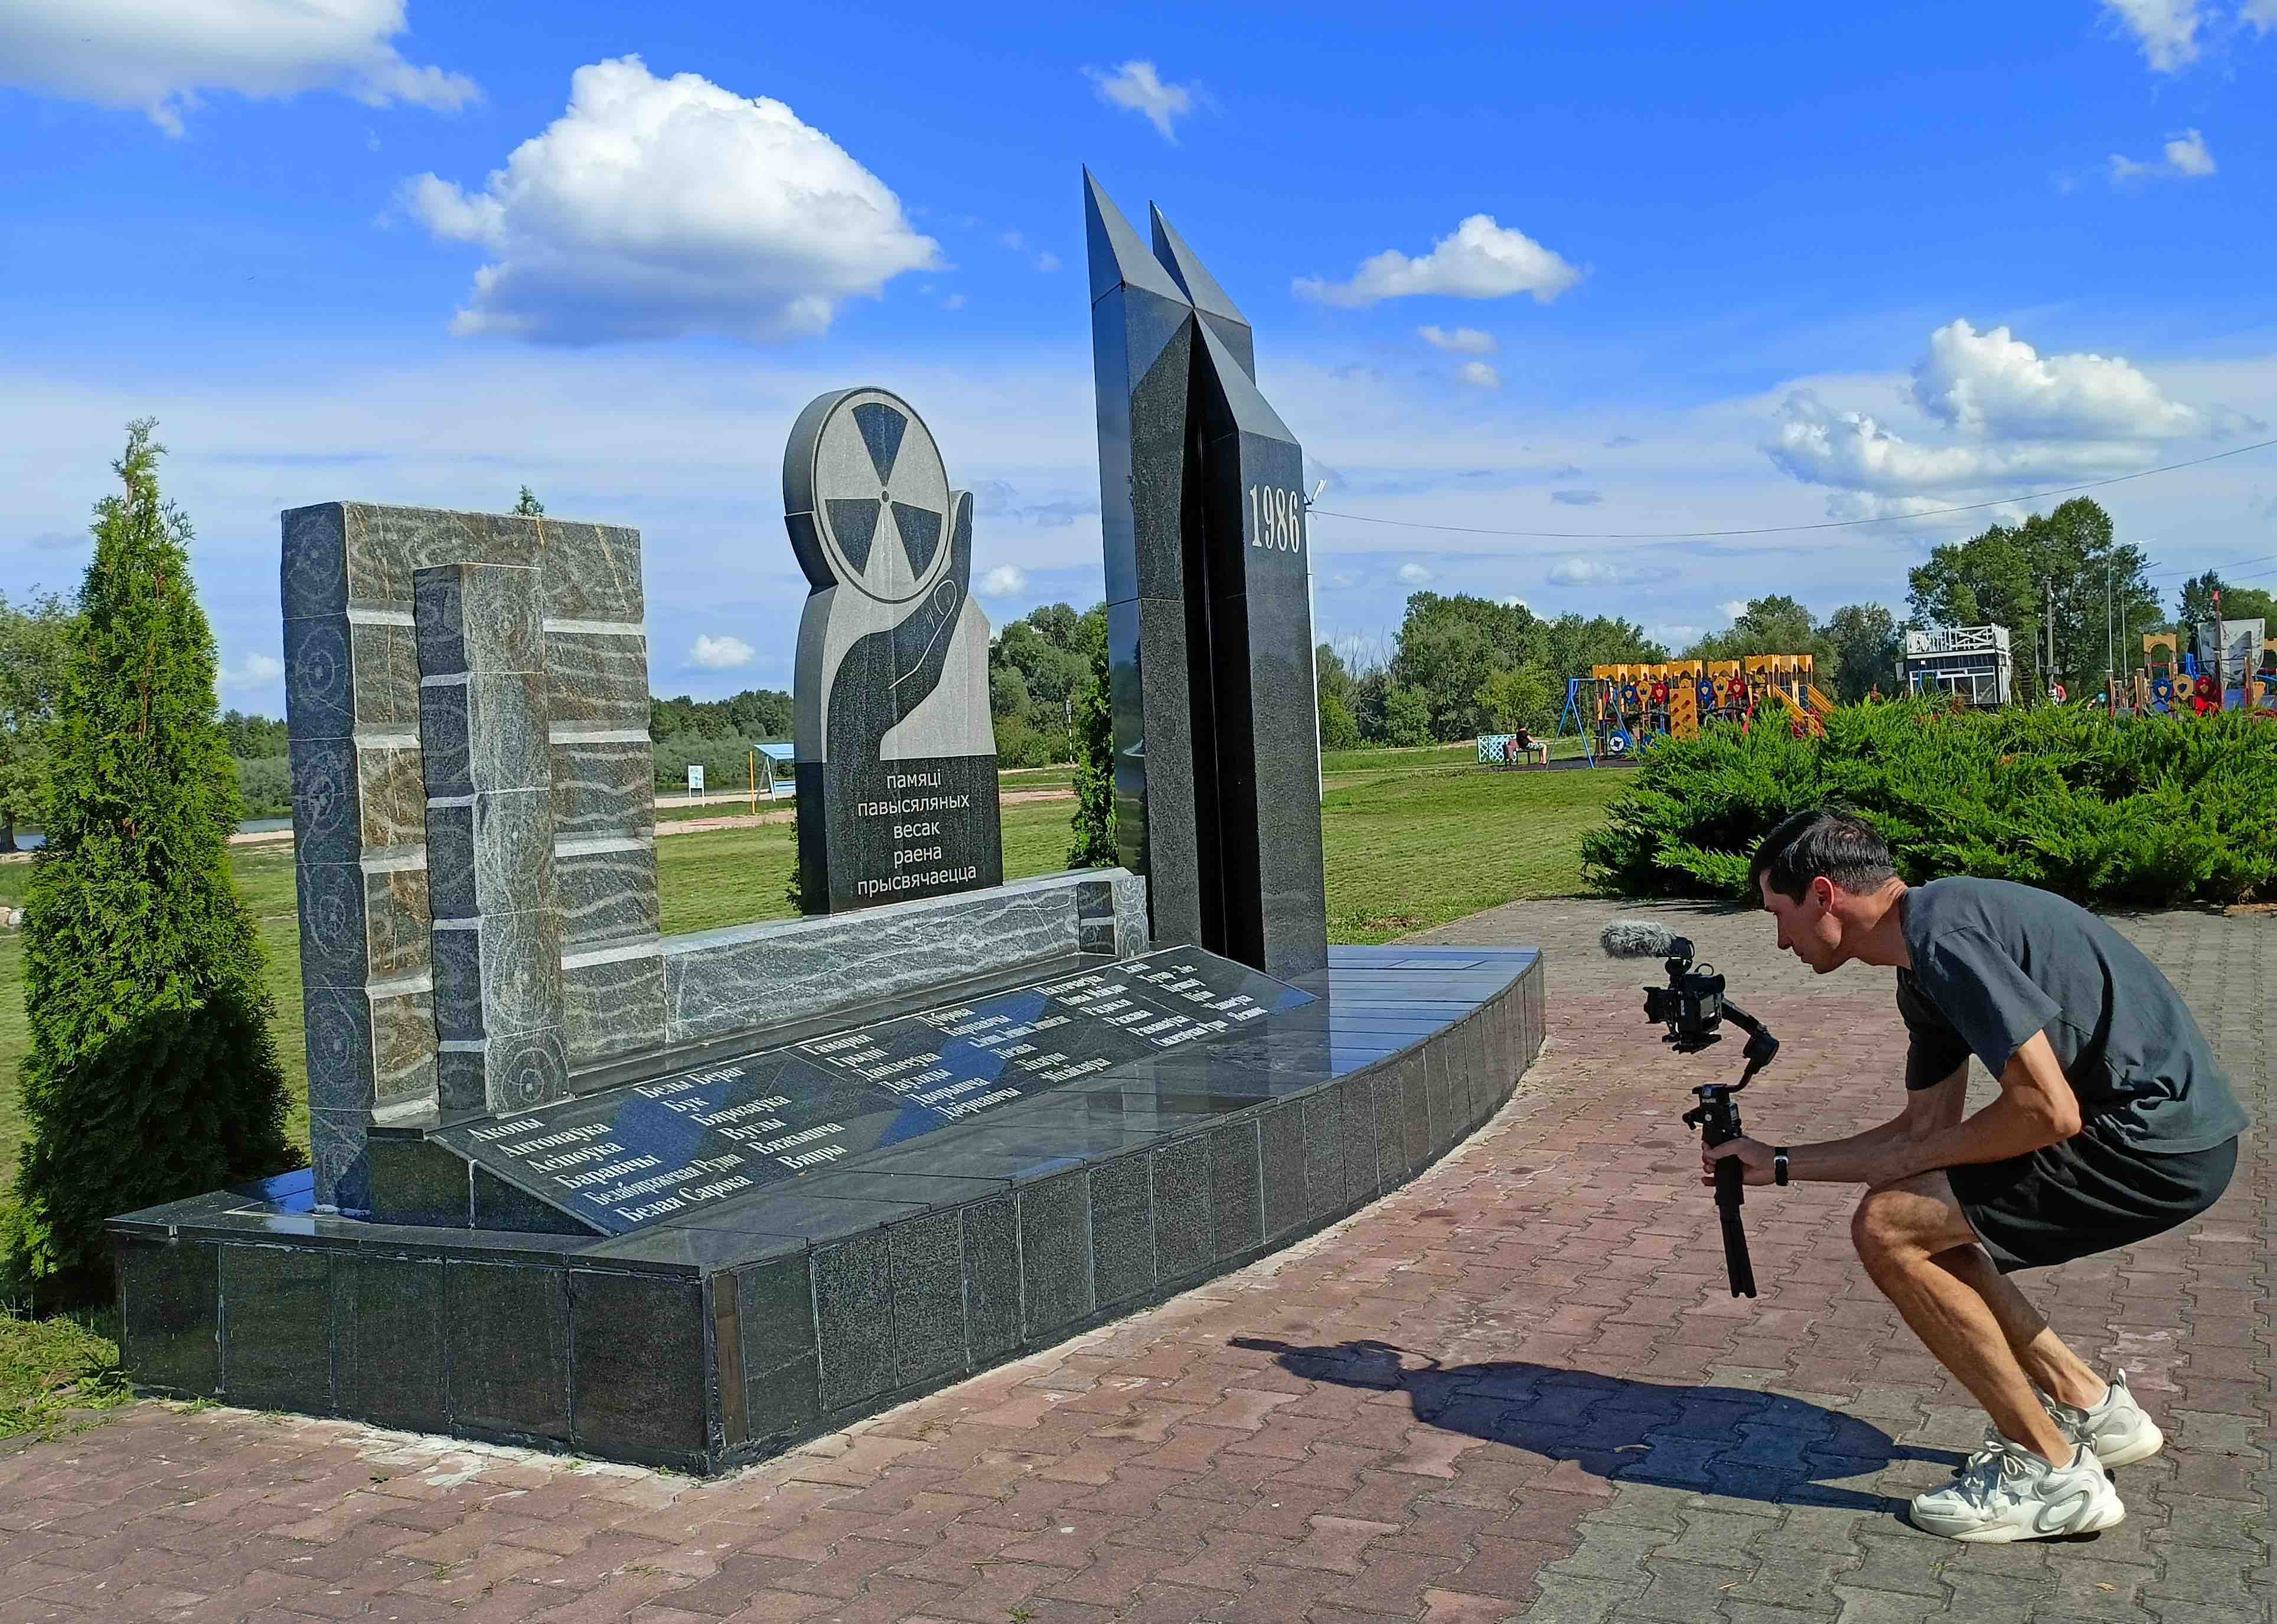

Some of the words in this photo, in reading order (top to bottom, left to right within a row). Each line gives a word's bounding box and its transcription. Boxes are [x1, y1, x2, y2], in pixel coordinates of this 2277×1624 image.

[1250, 484, 1299, 553] 1986
[887, 769, 941, 789] памяці
[858, 794, 970, 817] павысяляных
[893, 821, 941, 839] весак
[893, 846, 942, 869] раена
[858, 865, 977, 898] прысвячаецца
[632, 1080, 695, 1099] Белы
[685, 1067, 746, 1085] Бераг
[660, 1096, 710, 1112] Бук
[468, 1118, 546, 1142] Акопы
[497, 1122, 613, 1158] Антонаўка
[526, 1142, 626, 1174] Асіпоўка
[775, 1143, 849, 1169] Вяпры
[553, 1153, 662, 1190] Баравічы
[614, 1195, 687, 1223] Белая
[678, 1174, 754, 1202] Сарока
